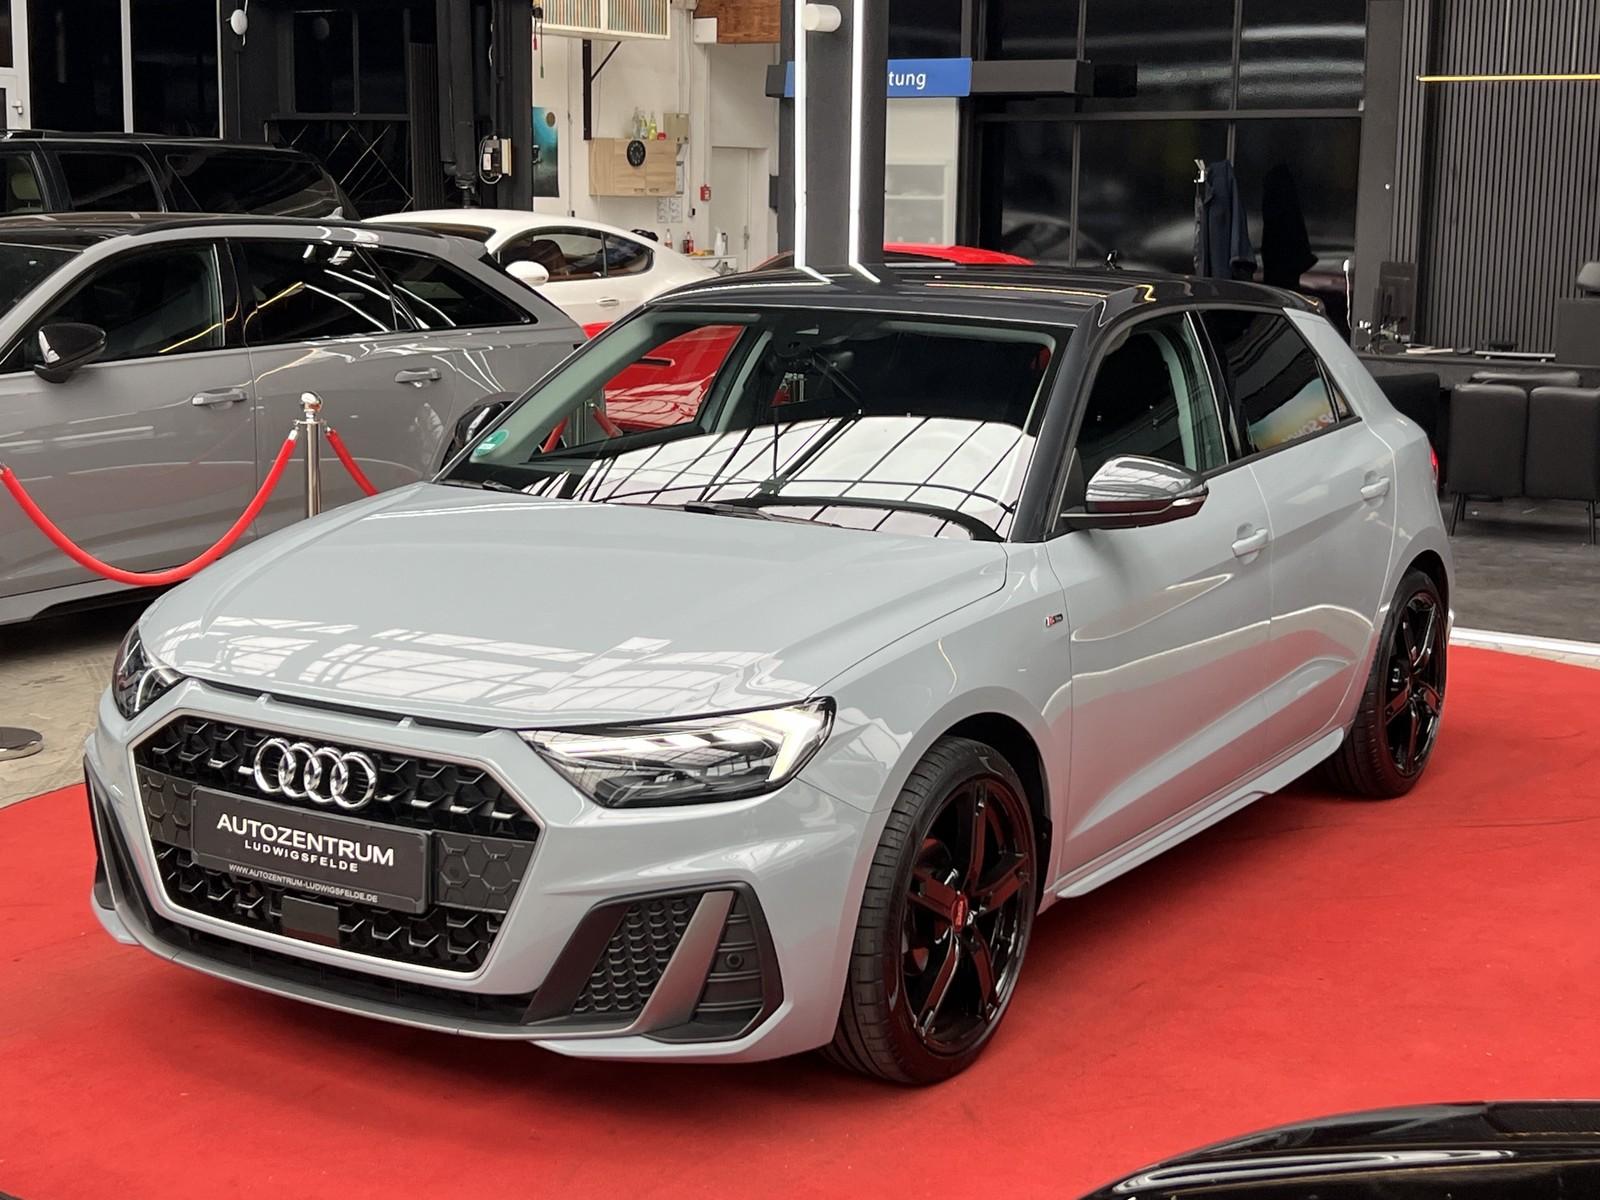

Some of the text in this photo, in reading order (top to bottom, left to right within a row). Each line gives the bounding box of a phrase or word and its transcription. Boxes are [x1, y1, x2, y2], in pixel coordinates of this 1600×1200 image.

[888, 71, 926, 90] tung
[217, 813, 394, 866] AUTOZENTRUM
[244, 840, 359, 872] LUDWIGSFELDE
[228, 863, 378, 904] WWW.AUTOZENTRUM-LUDWIGSFELDE.DE
